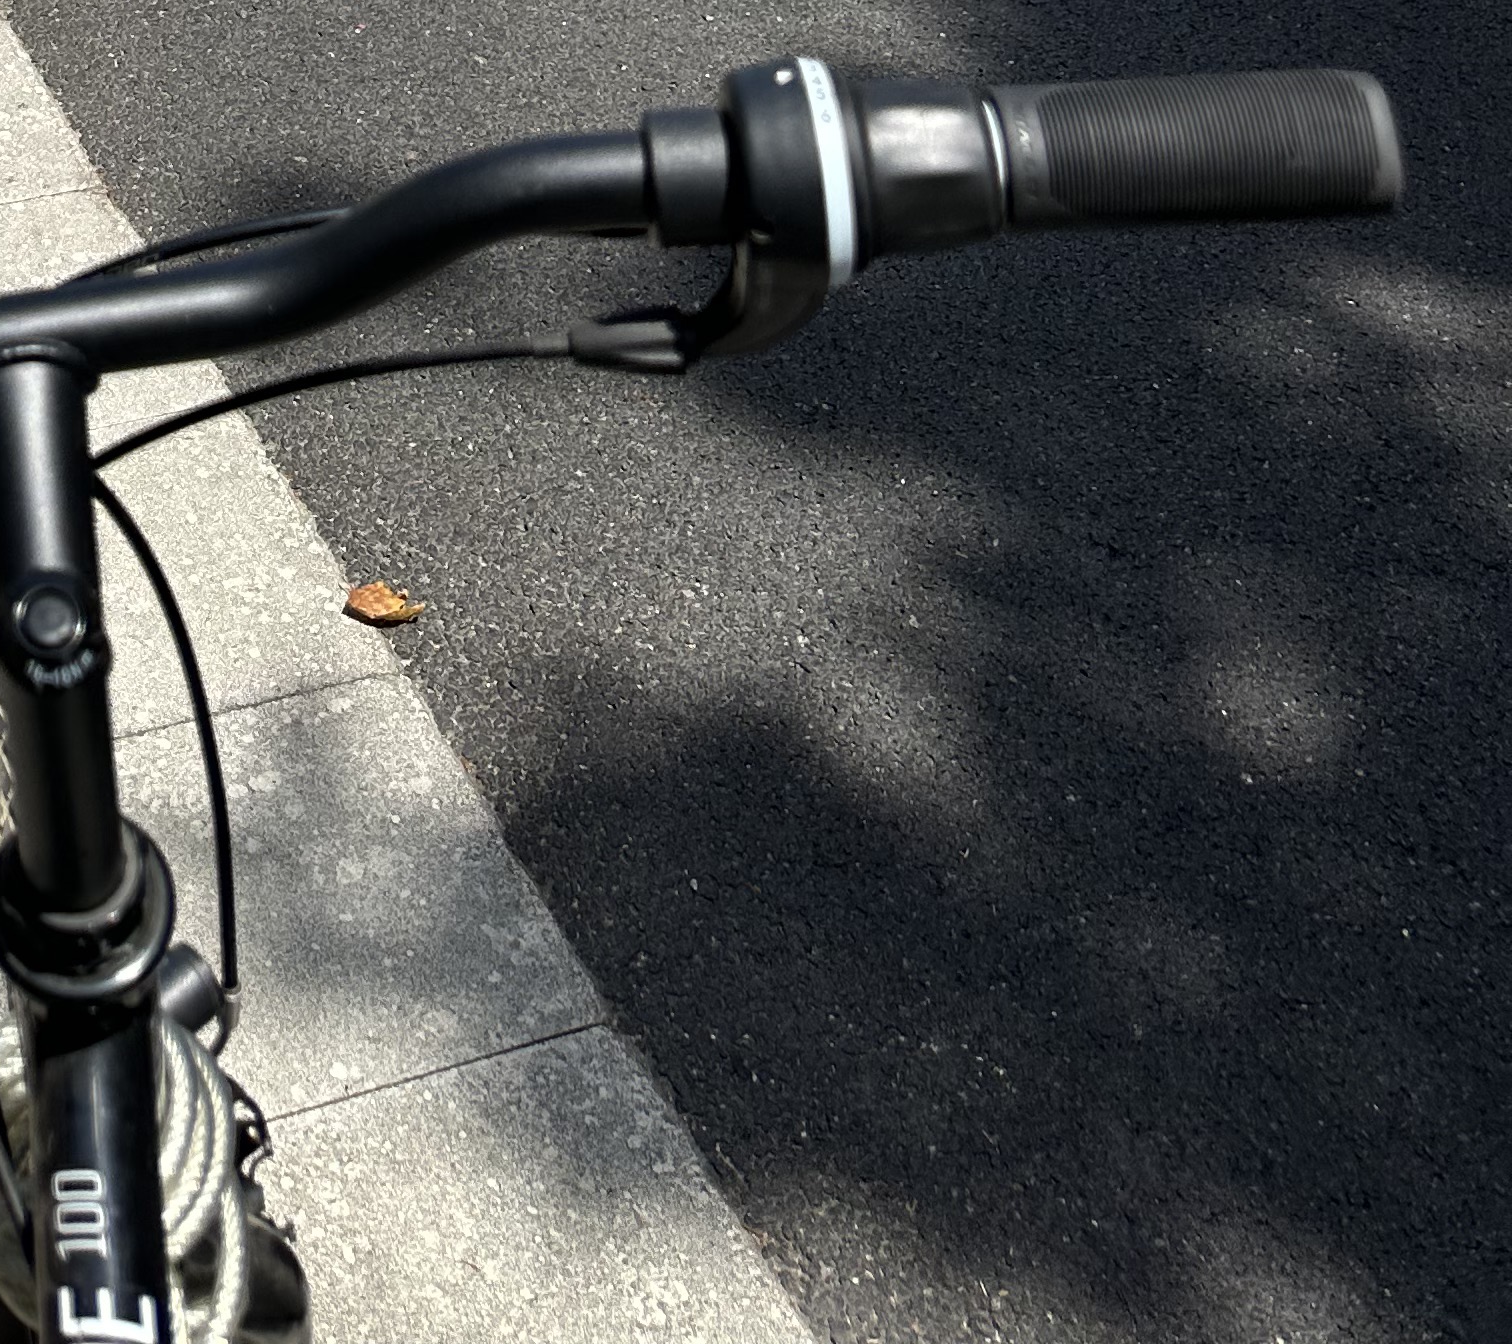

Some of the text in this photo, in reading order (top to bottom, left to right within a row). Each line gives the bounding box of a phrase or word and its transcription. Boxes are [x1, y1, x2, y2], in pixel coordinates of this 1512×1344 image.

[816, 88, 826, 100] 5
[821, 109, 831, 123] 6
[52, 1169, 157, 1344] E 100
